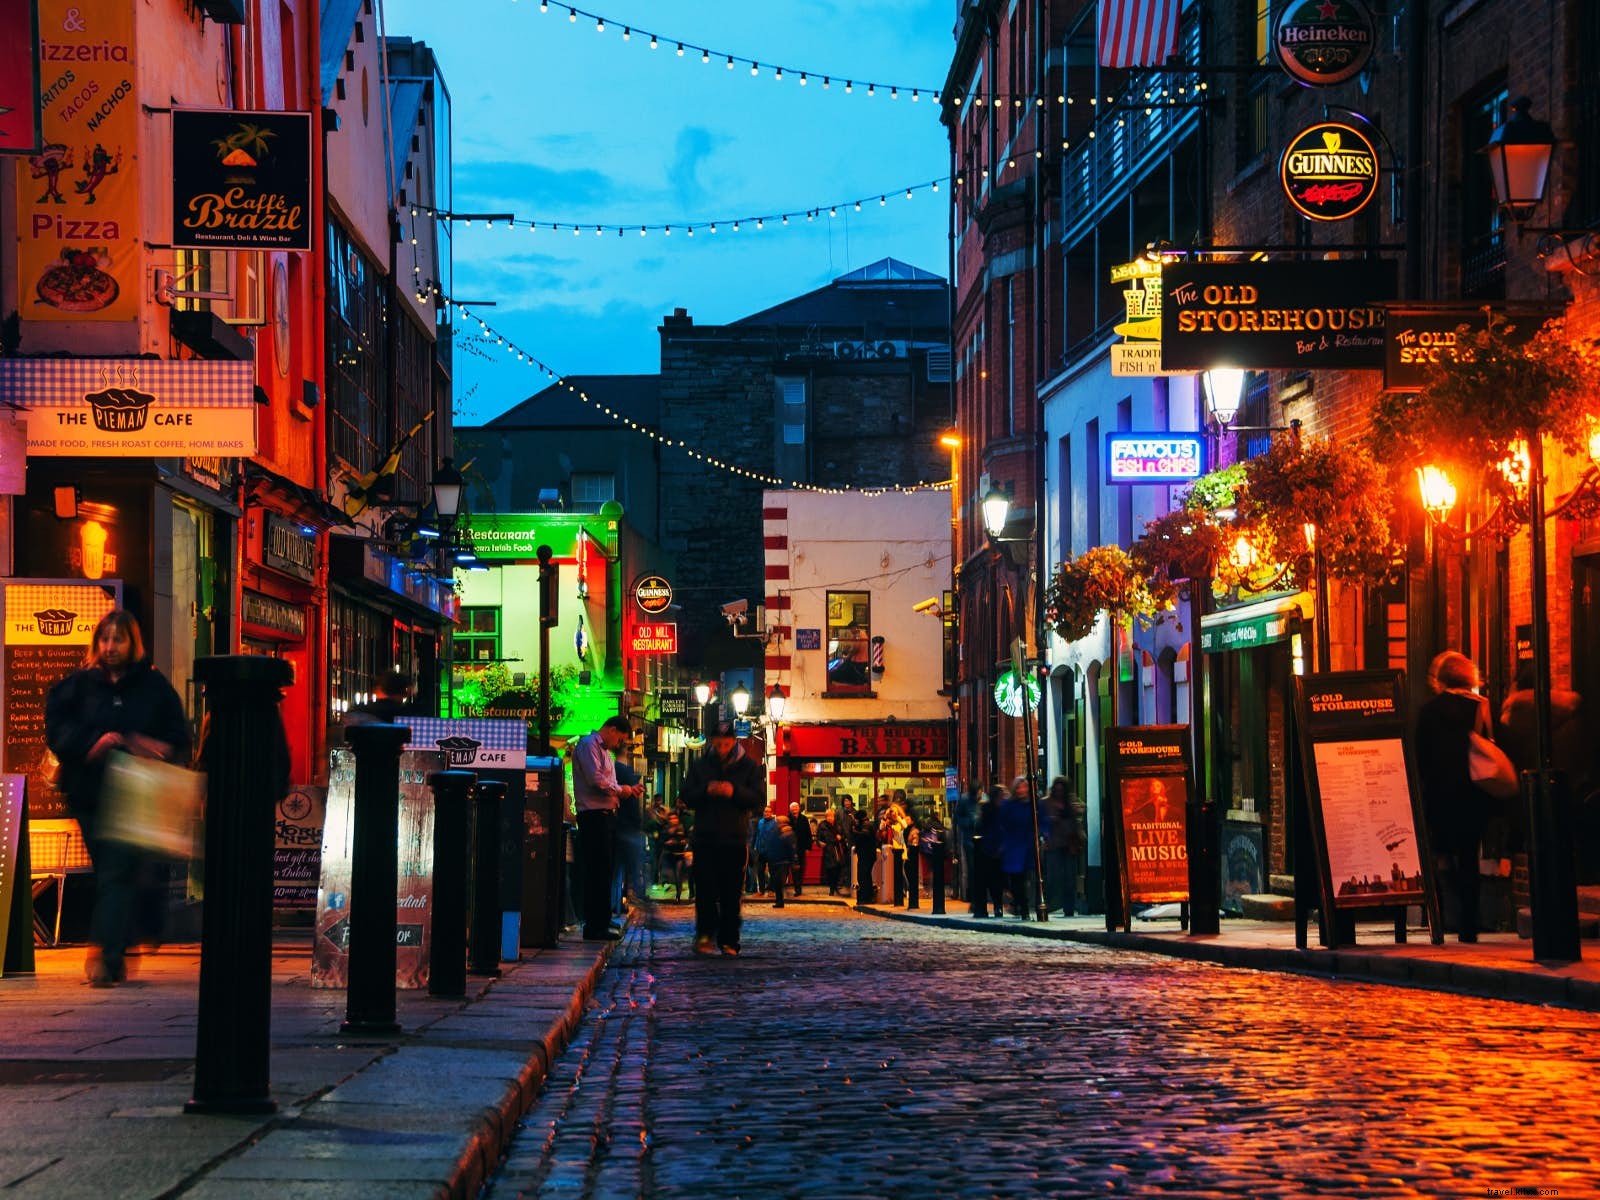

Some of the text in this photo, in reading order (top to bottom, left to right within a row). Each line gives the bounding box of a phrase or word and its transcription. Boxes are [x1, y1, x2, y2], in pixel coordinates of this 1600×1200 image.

[64, 8, 86, 31] &
[1285, 27, 1367, 42] Heineken
[41, 40, 127, 61] izzeria
[60, 80, 99, 122] TACOS
[87, 80, 132, 132] NACHOS
[1288, 154, 1372, 175] GUINNESS
[224, 187, 286, 214] Caffé
[183, 193, 301, 230] Brazil
[32, 214, 120, 240] Pizza
[195, 233, 236, 241] Restaurant,
[1111, 266, 1137, 280] LEO
[1170, 282, 1258, 306] The OLD
[1178, 308, 1385, 332] STOREHOUSE
[1296, 340, 1316, 355] Bar
[1334, 334, 1383, 347] Restauran
[1395, 329, 1456, 347] The OLD
[1121, 349, 1161, 358] TRADITI
[1120, 361, 1143, 372] FISH
[57, 410, 193, 429] THE PIEMAN CAFE
[26, 440, 244, 449] DMADE FOOD, FRESH ROAST COFFEE, HOME BAKES
[1116, 442, 1194, 458] FAMOUS
[1116, 459, 1143, 472] FISH
[1157, 459, 1195, 472] CHIPS
[468, 528, 535, 540] Restaurant
[513, 544, 533, 552] Food
[638, 588, 670, 597] GUINNESS
[15, 620, 96, 635] THE PIEMAN CAF
[639, 626, 669, 638] OLD MILL
[633, 639, 673, 651] RESTAURANT
[1313, 699, 1393, 712] STOREHOUSE
[1321, 694, 1343, 703] OLD
[469, 705, 537, 718] Restaurant
[842, 738, 947, 755] BARBE
[1119, 745, 1180, 755] STOREHOUSE
[1127, 740, 1143, 748] OLD
[451, 751, 506, 765] EMAN CAFE
[1131, 821, 1182, 831] TRADITIONAL
[1137, 830, 1179, 846] LIVE
[274, 851, 290, 862] best
[291, 851, 306, 866] gift
[1131, 845, 1188, 861] MUSIC
[281, 868, 312, 878] Dublin
